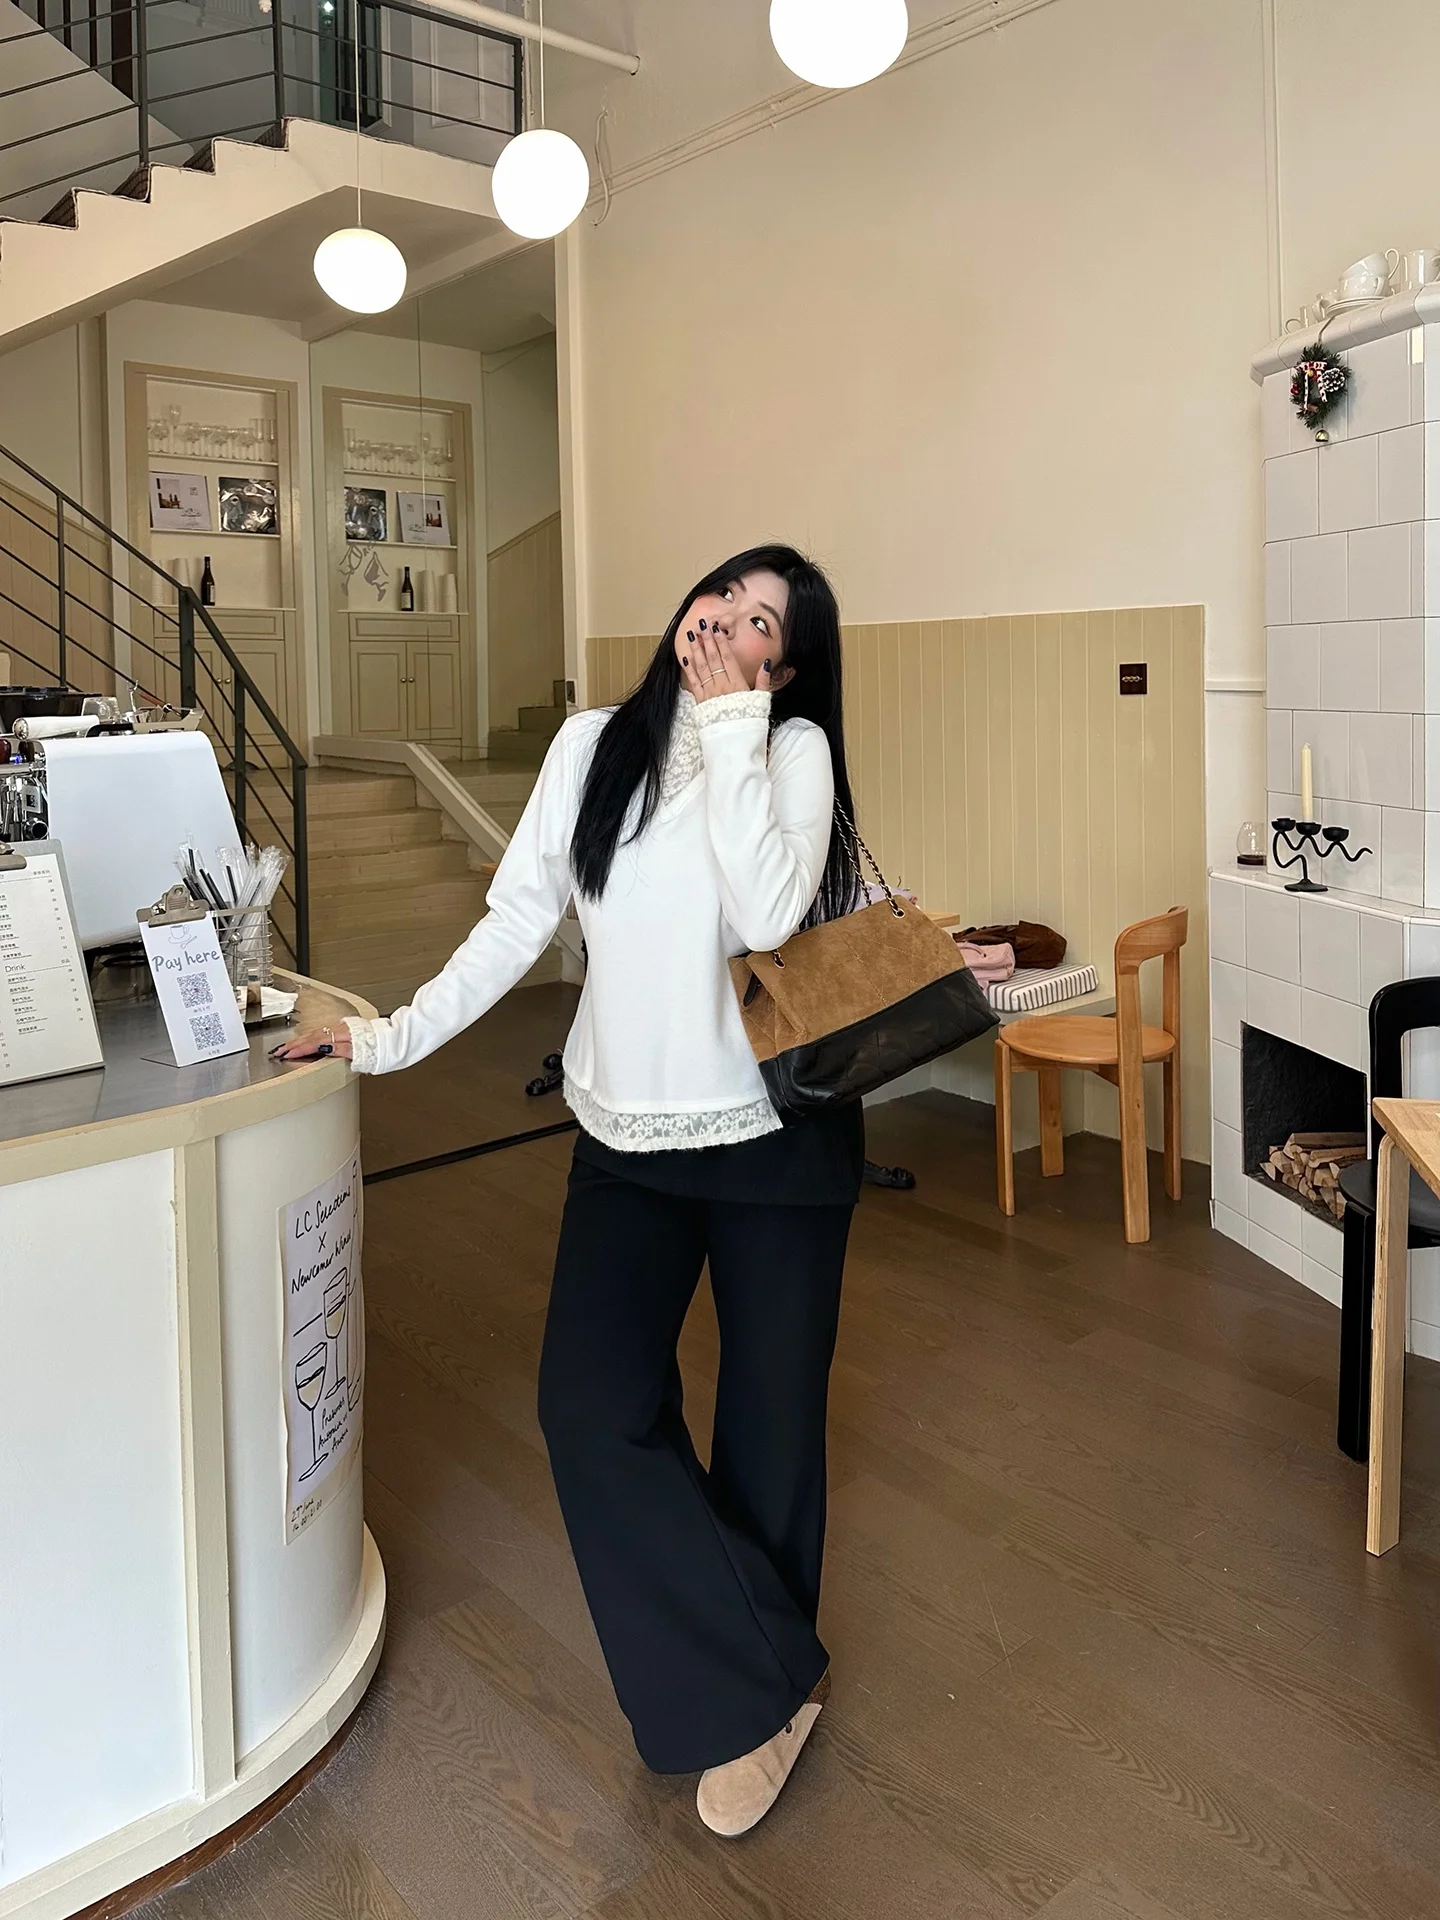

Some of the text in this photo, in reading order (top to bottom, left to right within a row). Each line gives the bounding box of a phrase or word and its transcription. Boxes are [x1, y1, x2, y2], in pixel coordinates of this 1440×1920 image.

[4, 963, 26, 973] Drink
[152, 950, 220, 972] Pay here
[296, 1210, 313, 1239] LC
[291, 1252, 334, 1295] Newcomer
